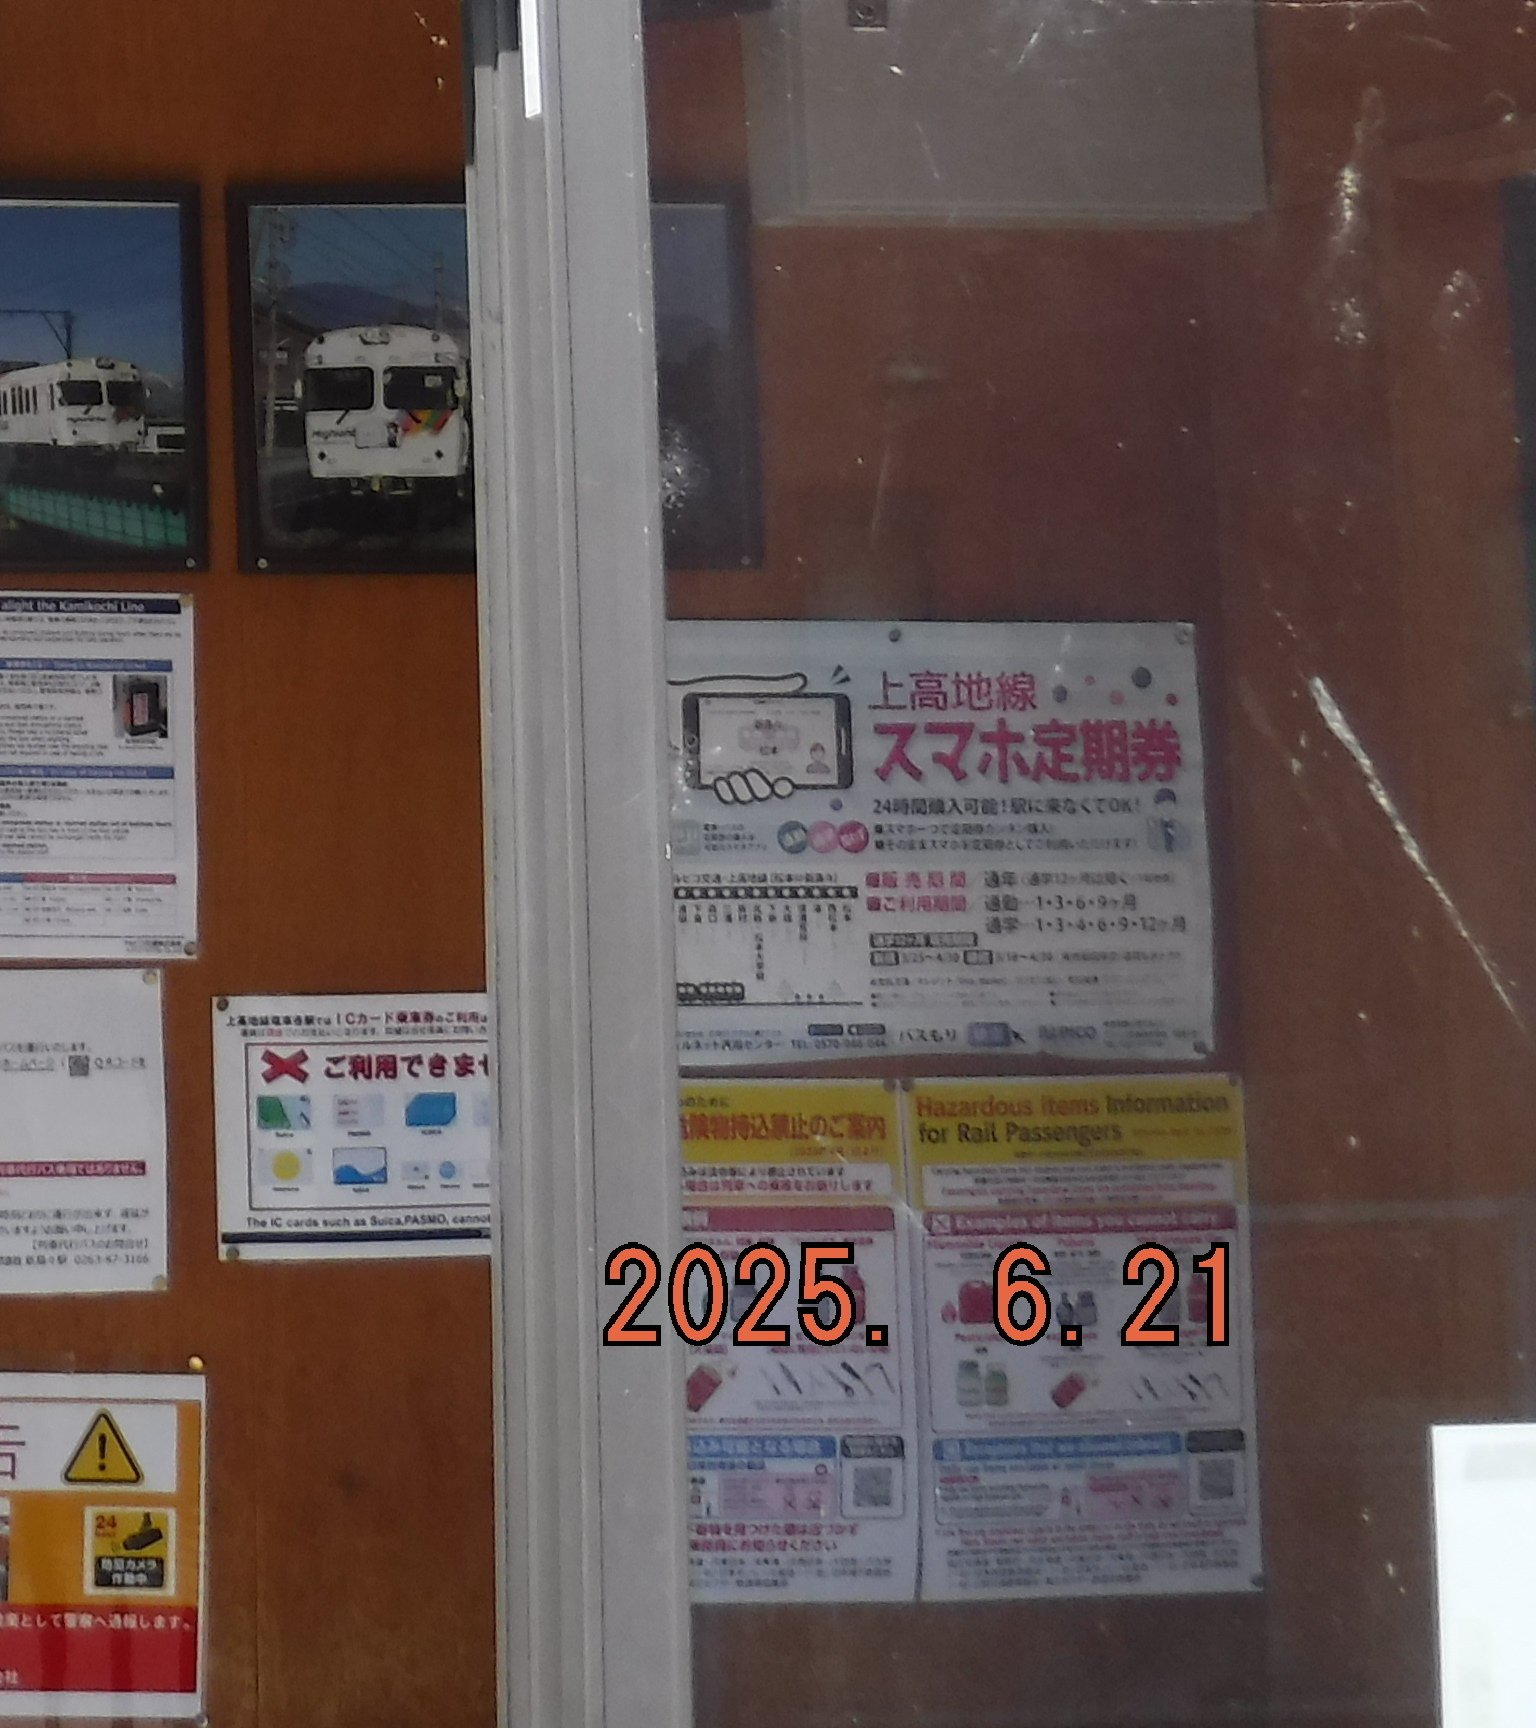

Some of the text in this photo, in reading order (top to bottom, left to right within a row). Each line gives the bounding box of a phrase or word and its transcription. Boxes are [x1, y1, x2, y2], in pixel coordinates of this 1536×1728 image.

[868, 670, 1038, 712] 上高地線
[872, 717, 1183, 784] スマホ定期券
[915, 1095, 1033, 1119] Hazardous
[918, 1122, 1123, 1148] for Rail Passengers
